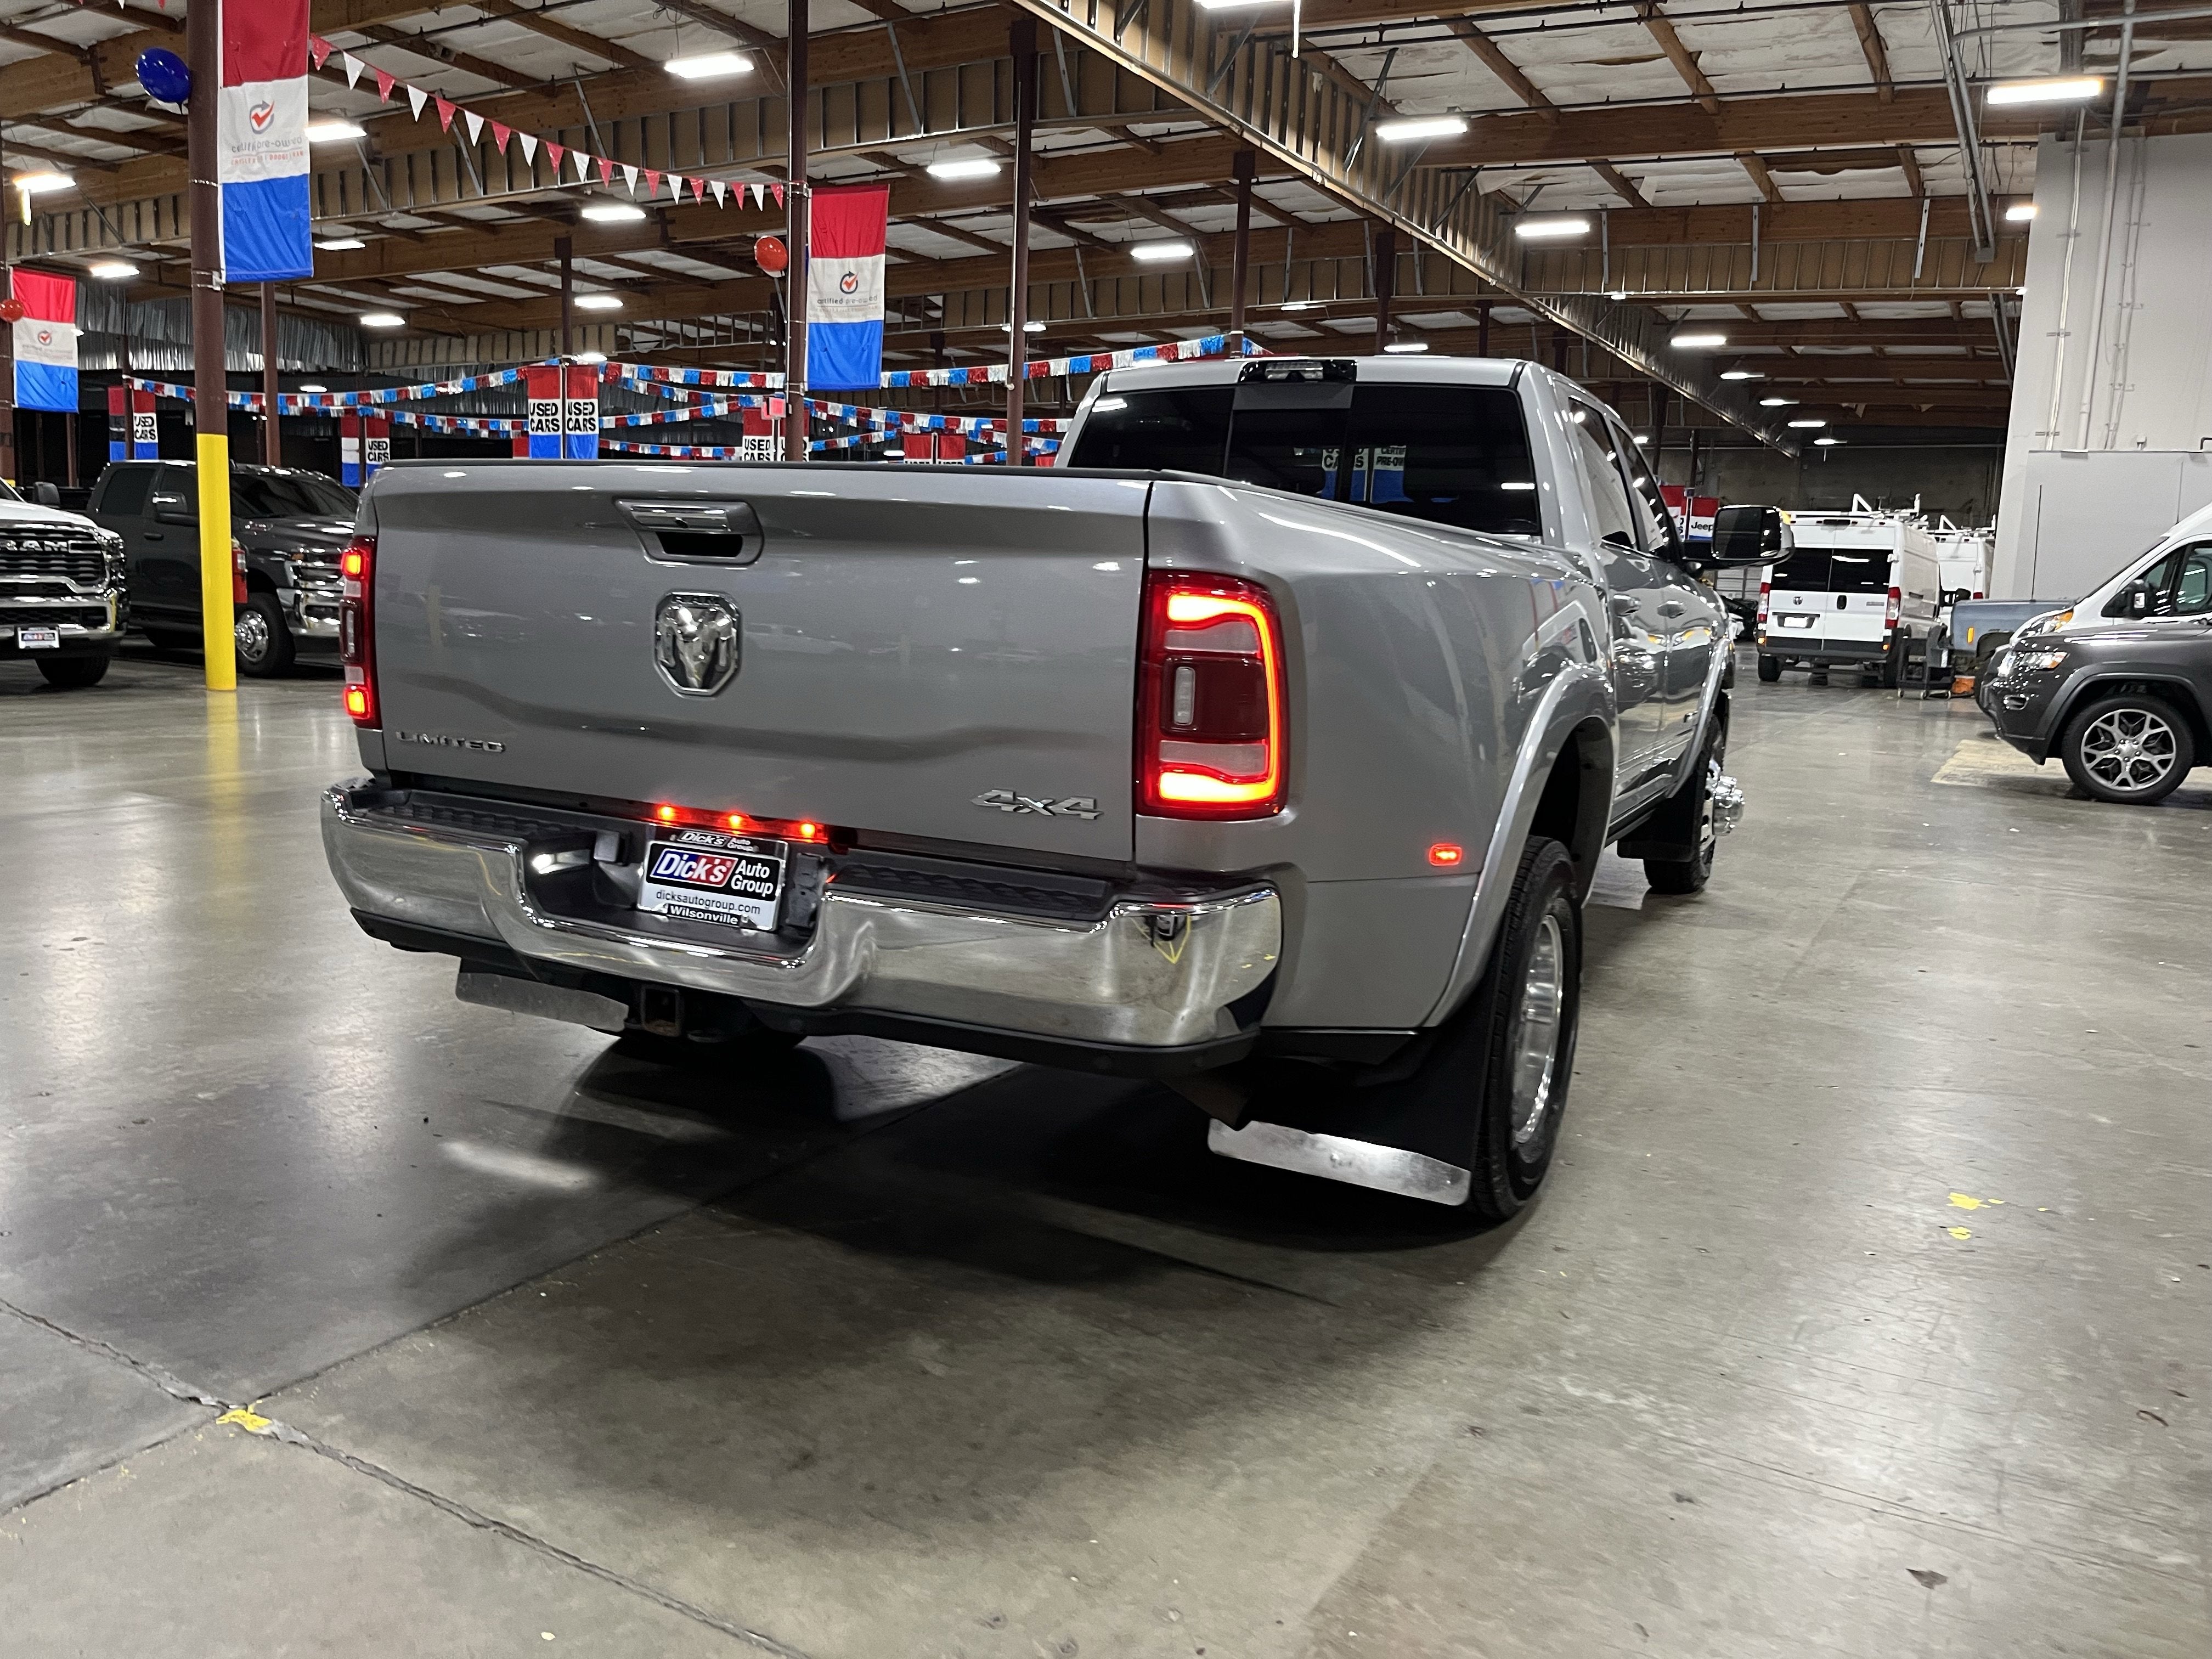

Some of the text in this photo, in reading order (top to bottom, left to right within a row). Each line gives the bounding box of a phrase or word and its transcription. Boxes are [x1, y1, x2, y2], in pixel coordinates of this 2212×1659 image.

[531, 402, 558, 417] USED
[567, 401, 595, 416] USED
[530, 417, 560, 432] CARS
[567, 417, 596, 432] CARS
[368, 441, 388, 450] USED
[744, 439, 770, 451] USED
[744, 452, 771, 461] CARS
[395, 731, 506, 753] LIMITED
[736, 860, 770, 878] Auto
[731, 874, 774, 897] Group
[656, 889, 760, 915] dicksautogroup.com
[670, 905, 738, 925] Wilsonville
